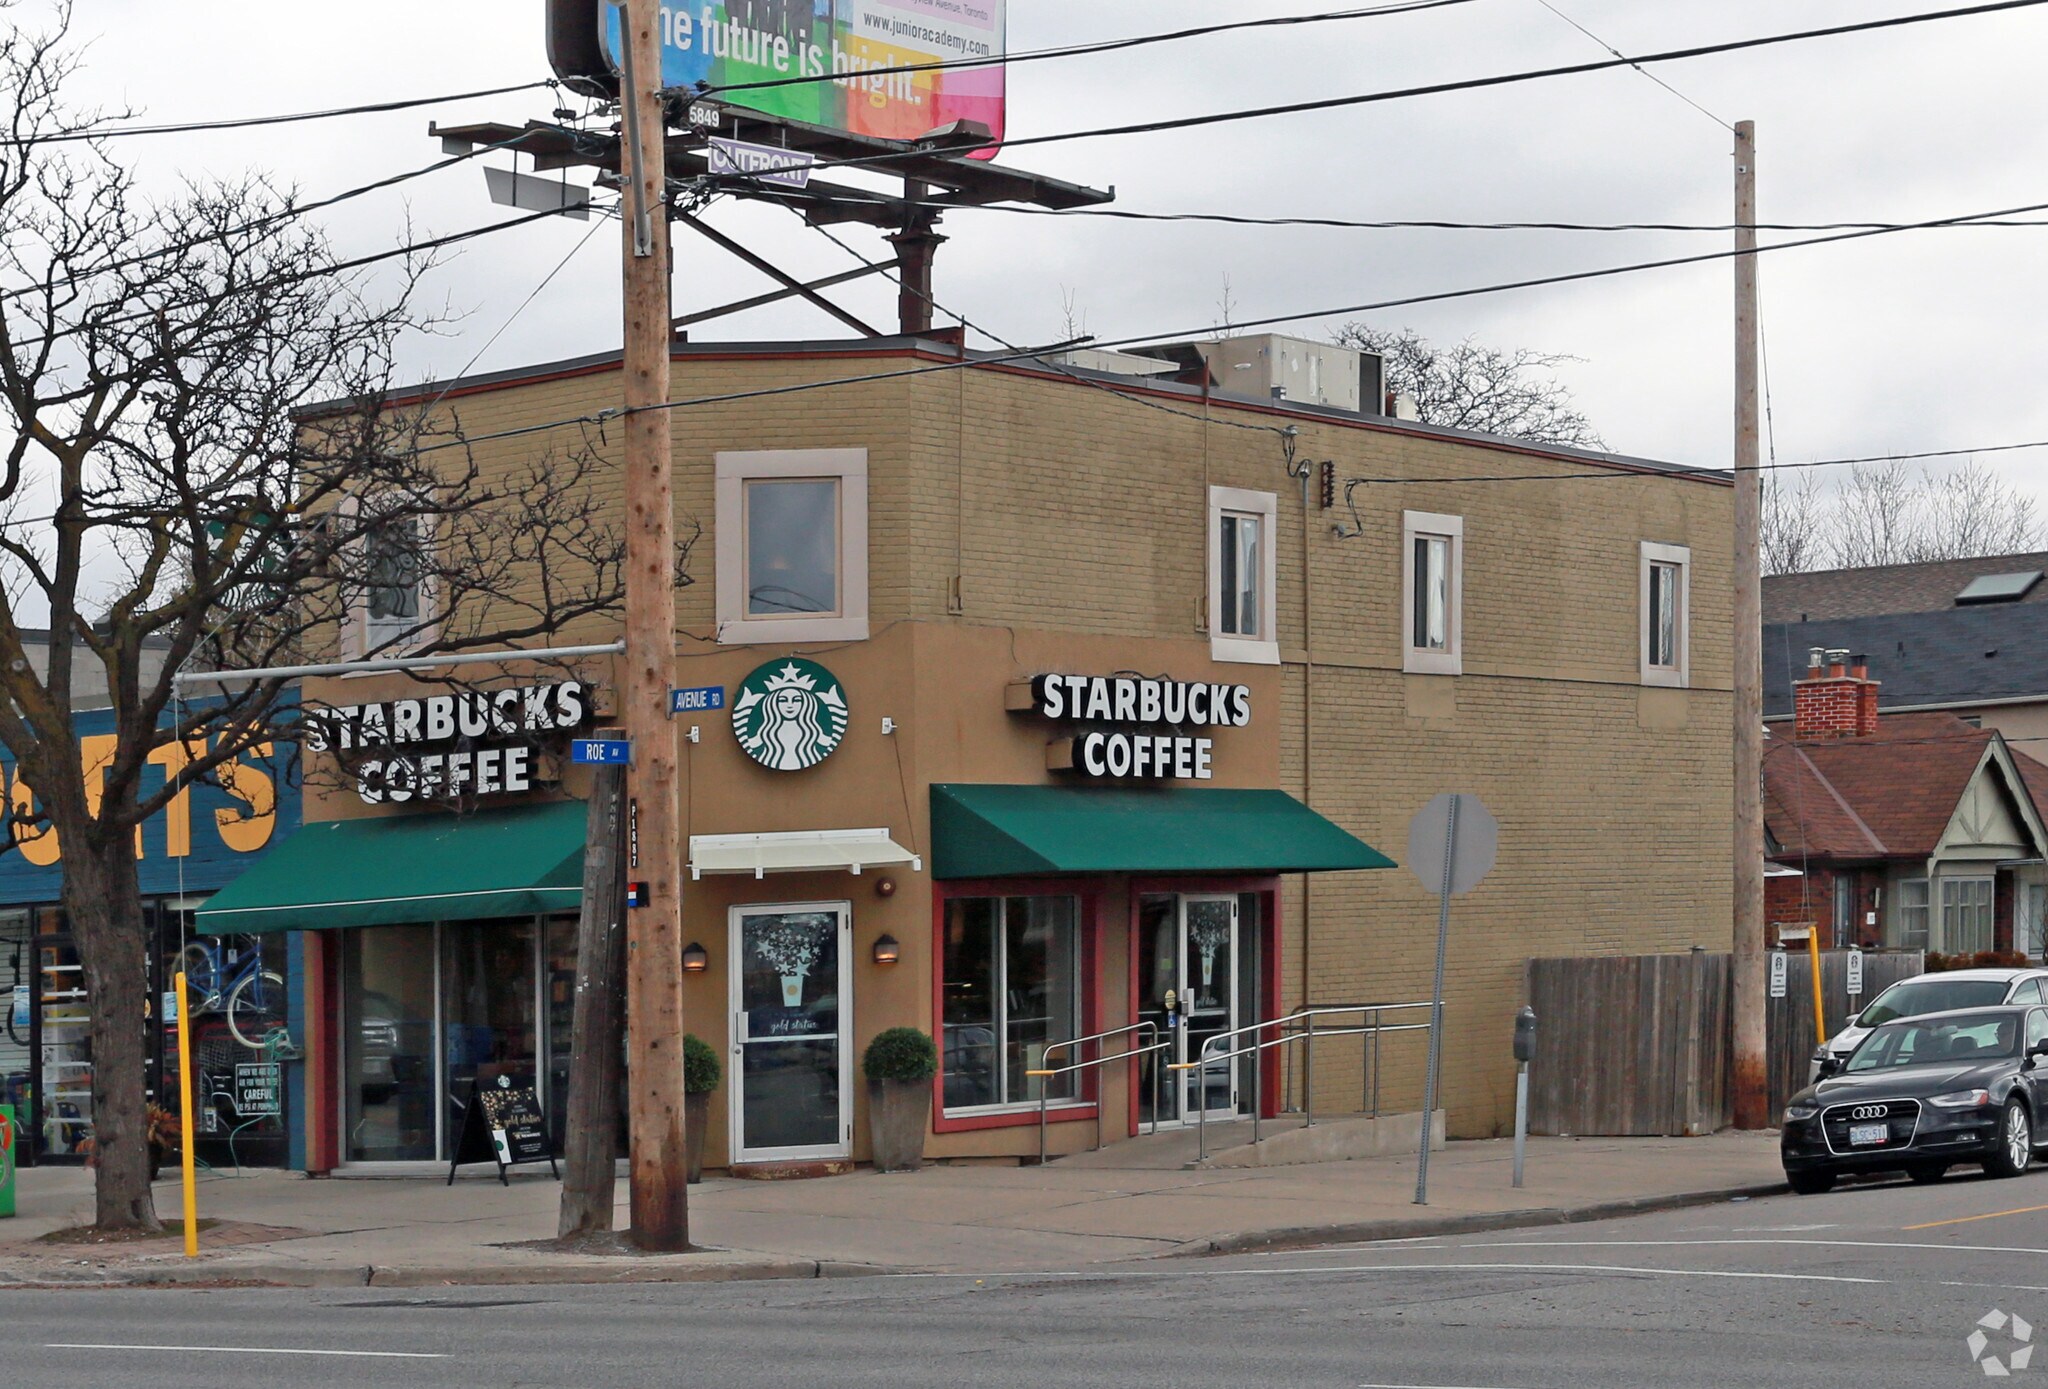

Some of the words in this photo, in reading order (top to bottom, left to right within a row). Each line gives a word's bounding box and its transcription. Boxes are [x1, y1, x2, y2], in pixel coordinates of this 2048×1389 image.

[863, 12, 990, 56] www.junioracademy.com
[964, 4, 988, 21] Toronto
[700, 6, 789, 72] future
[800, 29, 824, 77] is
[832, 39, 921, 109] bright.
[689, 106, 720, 128] 5849
[306, 681, 582, 752] STARBUCKS
[676, 690, 707, 708] AVENUE
[712, 693, 720, 706] RD
[1043, 673, 1250, 727] STARBUCKS
[586, 743, 605, 760] ROE
[1084, 732, 1212, 779] COFFEE
[357, 746, 529, 805] COFFEE
[244, 1089, 273, 1100] CAREFUL
